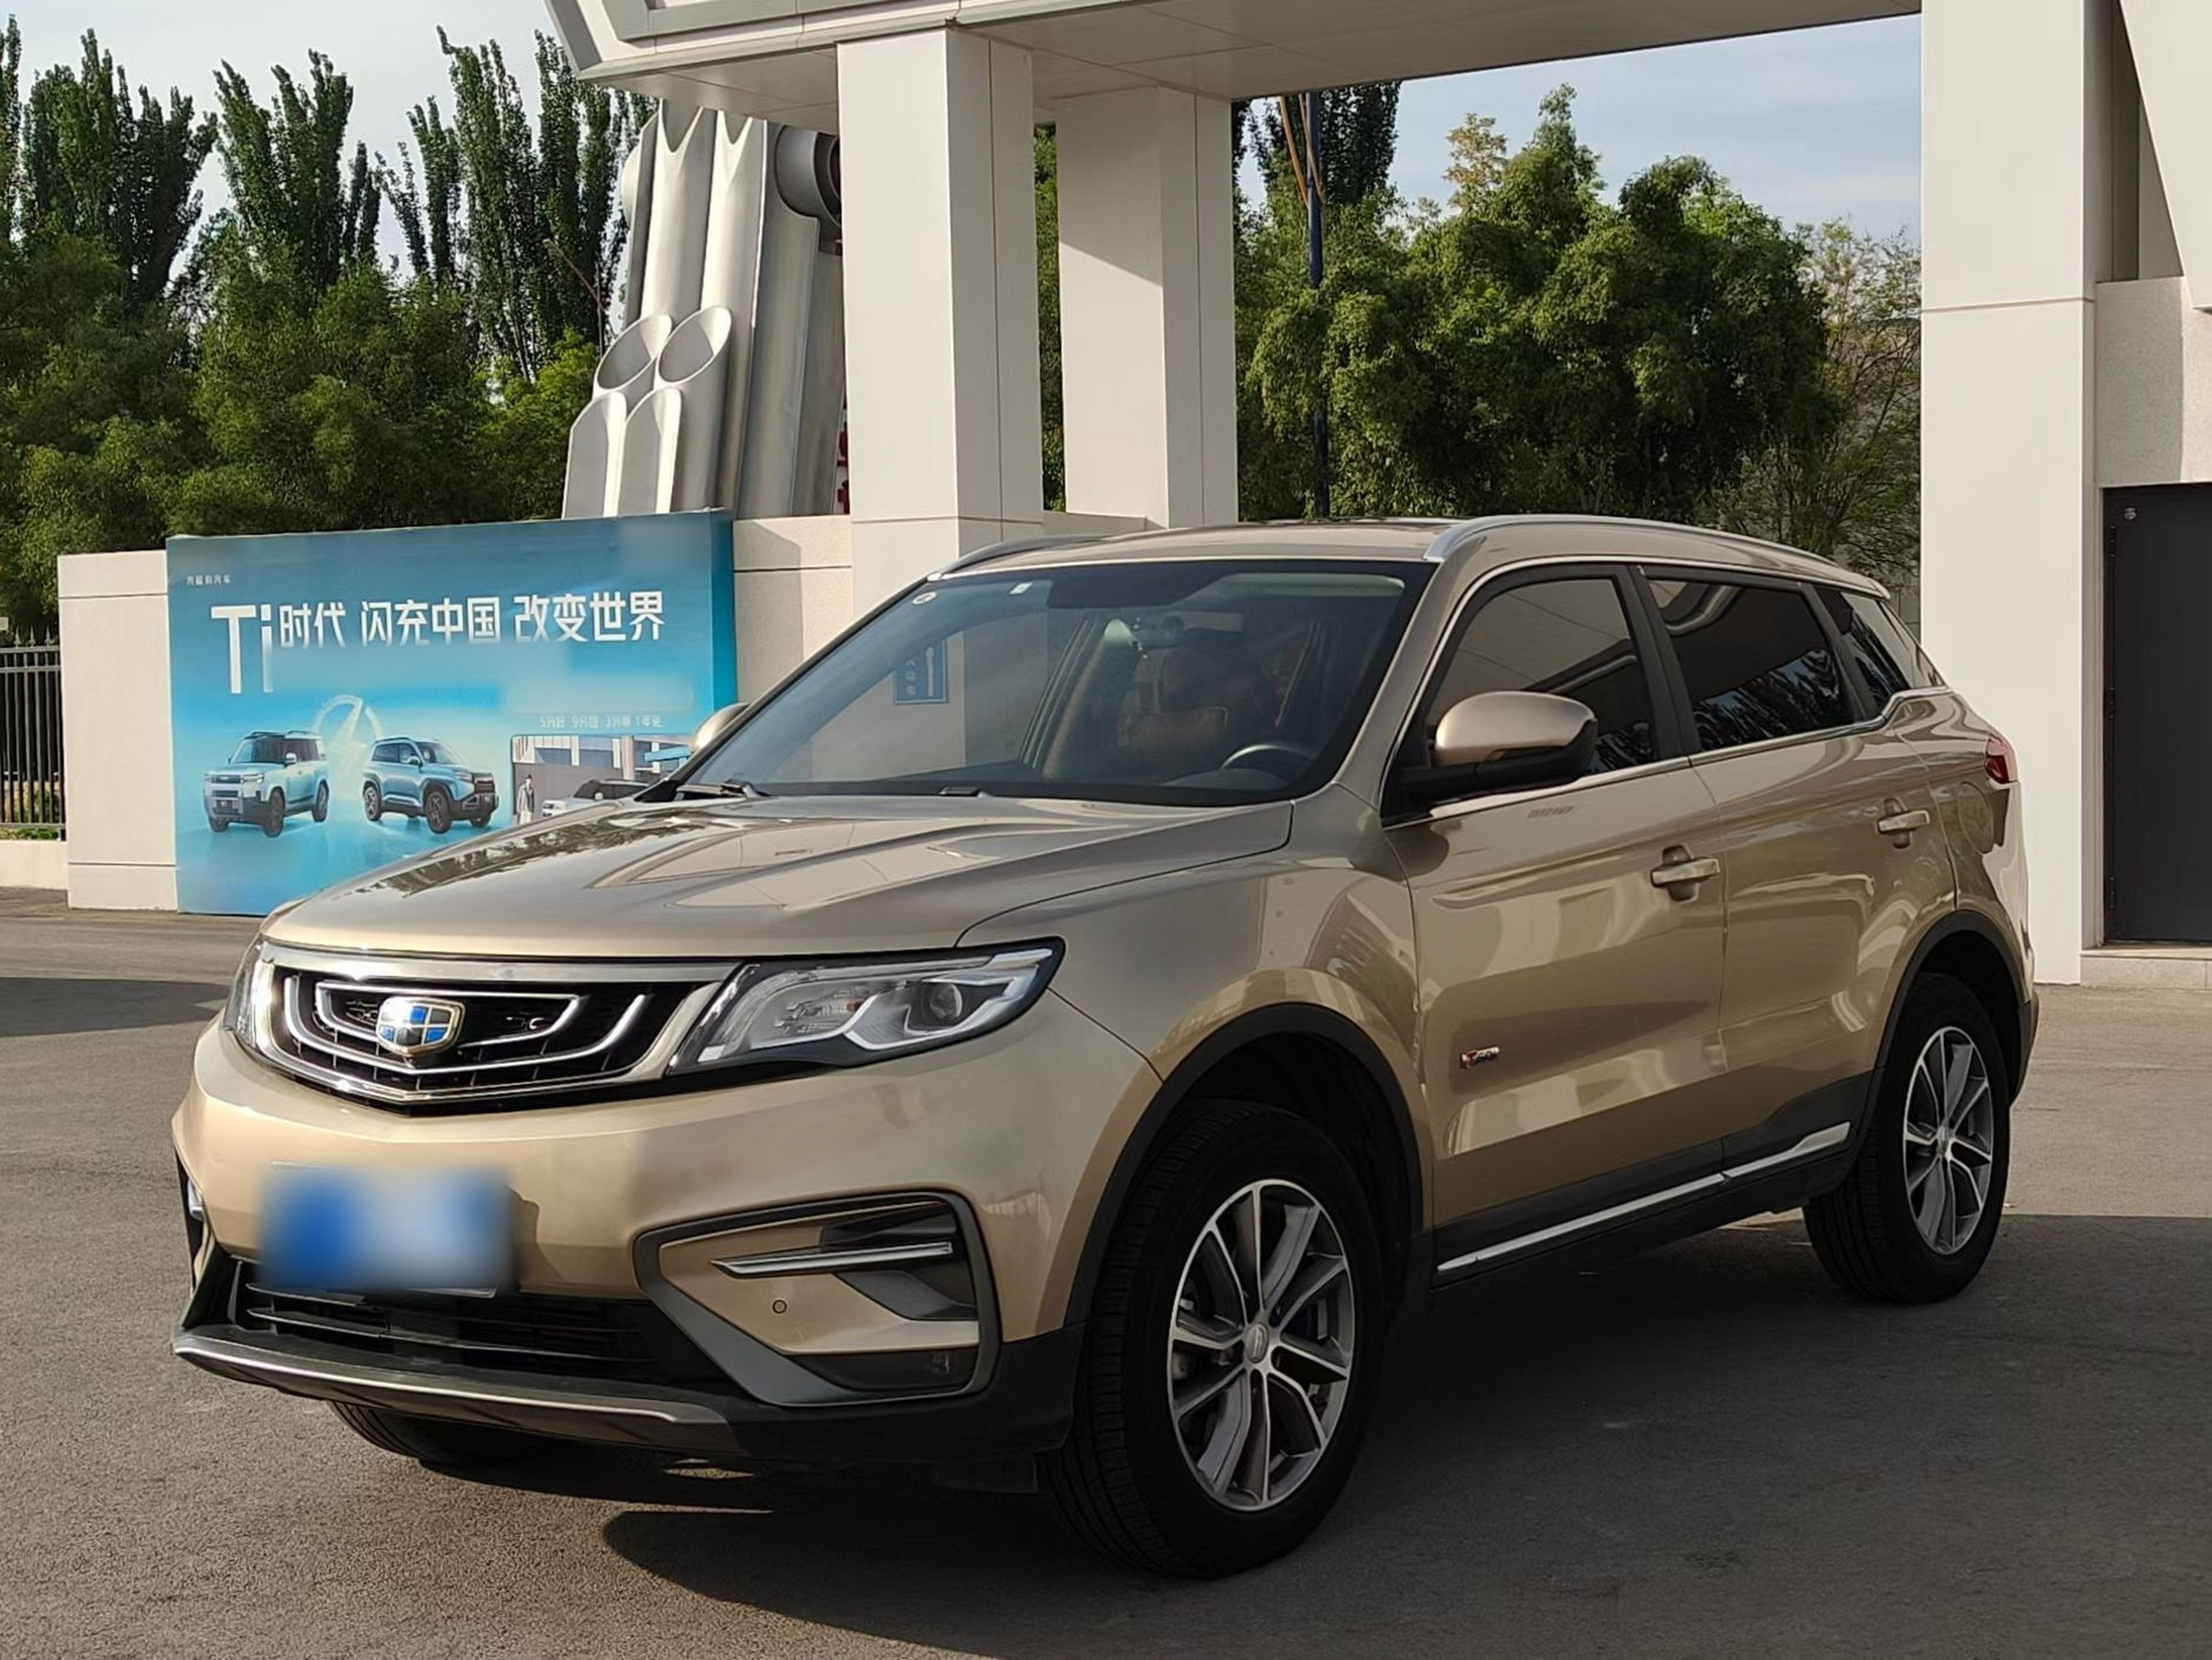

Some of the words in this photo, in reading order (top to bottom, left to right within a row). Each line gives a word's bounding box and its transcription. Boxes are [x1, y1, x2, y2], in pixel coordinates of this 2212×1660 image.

[360, 596, 502, 648] 闪充中国
[513, 590, 665, 643] 改变世界
